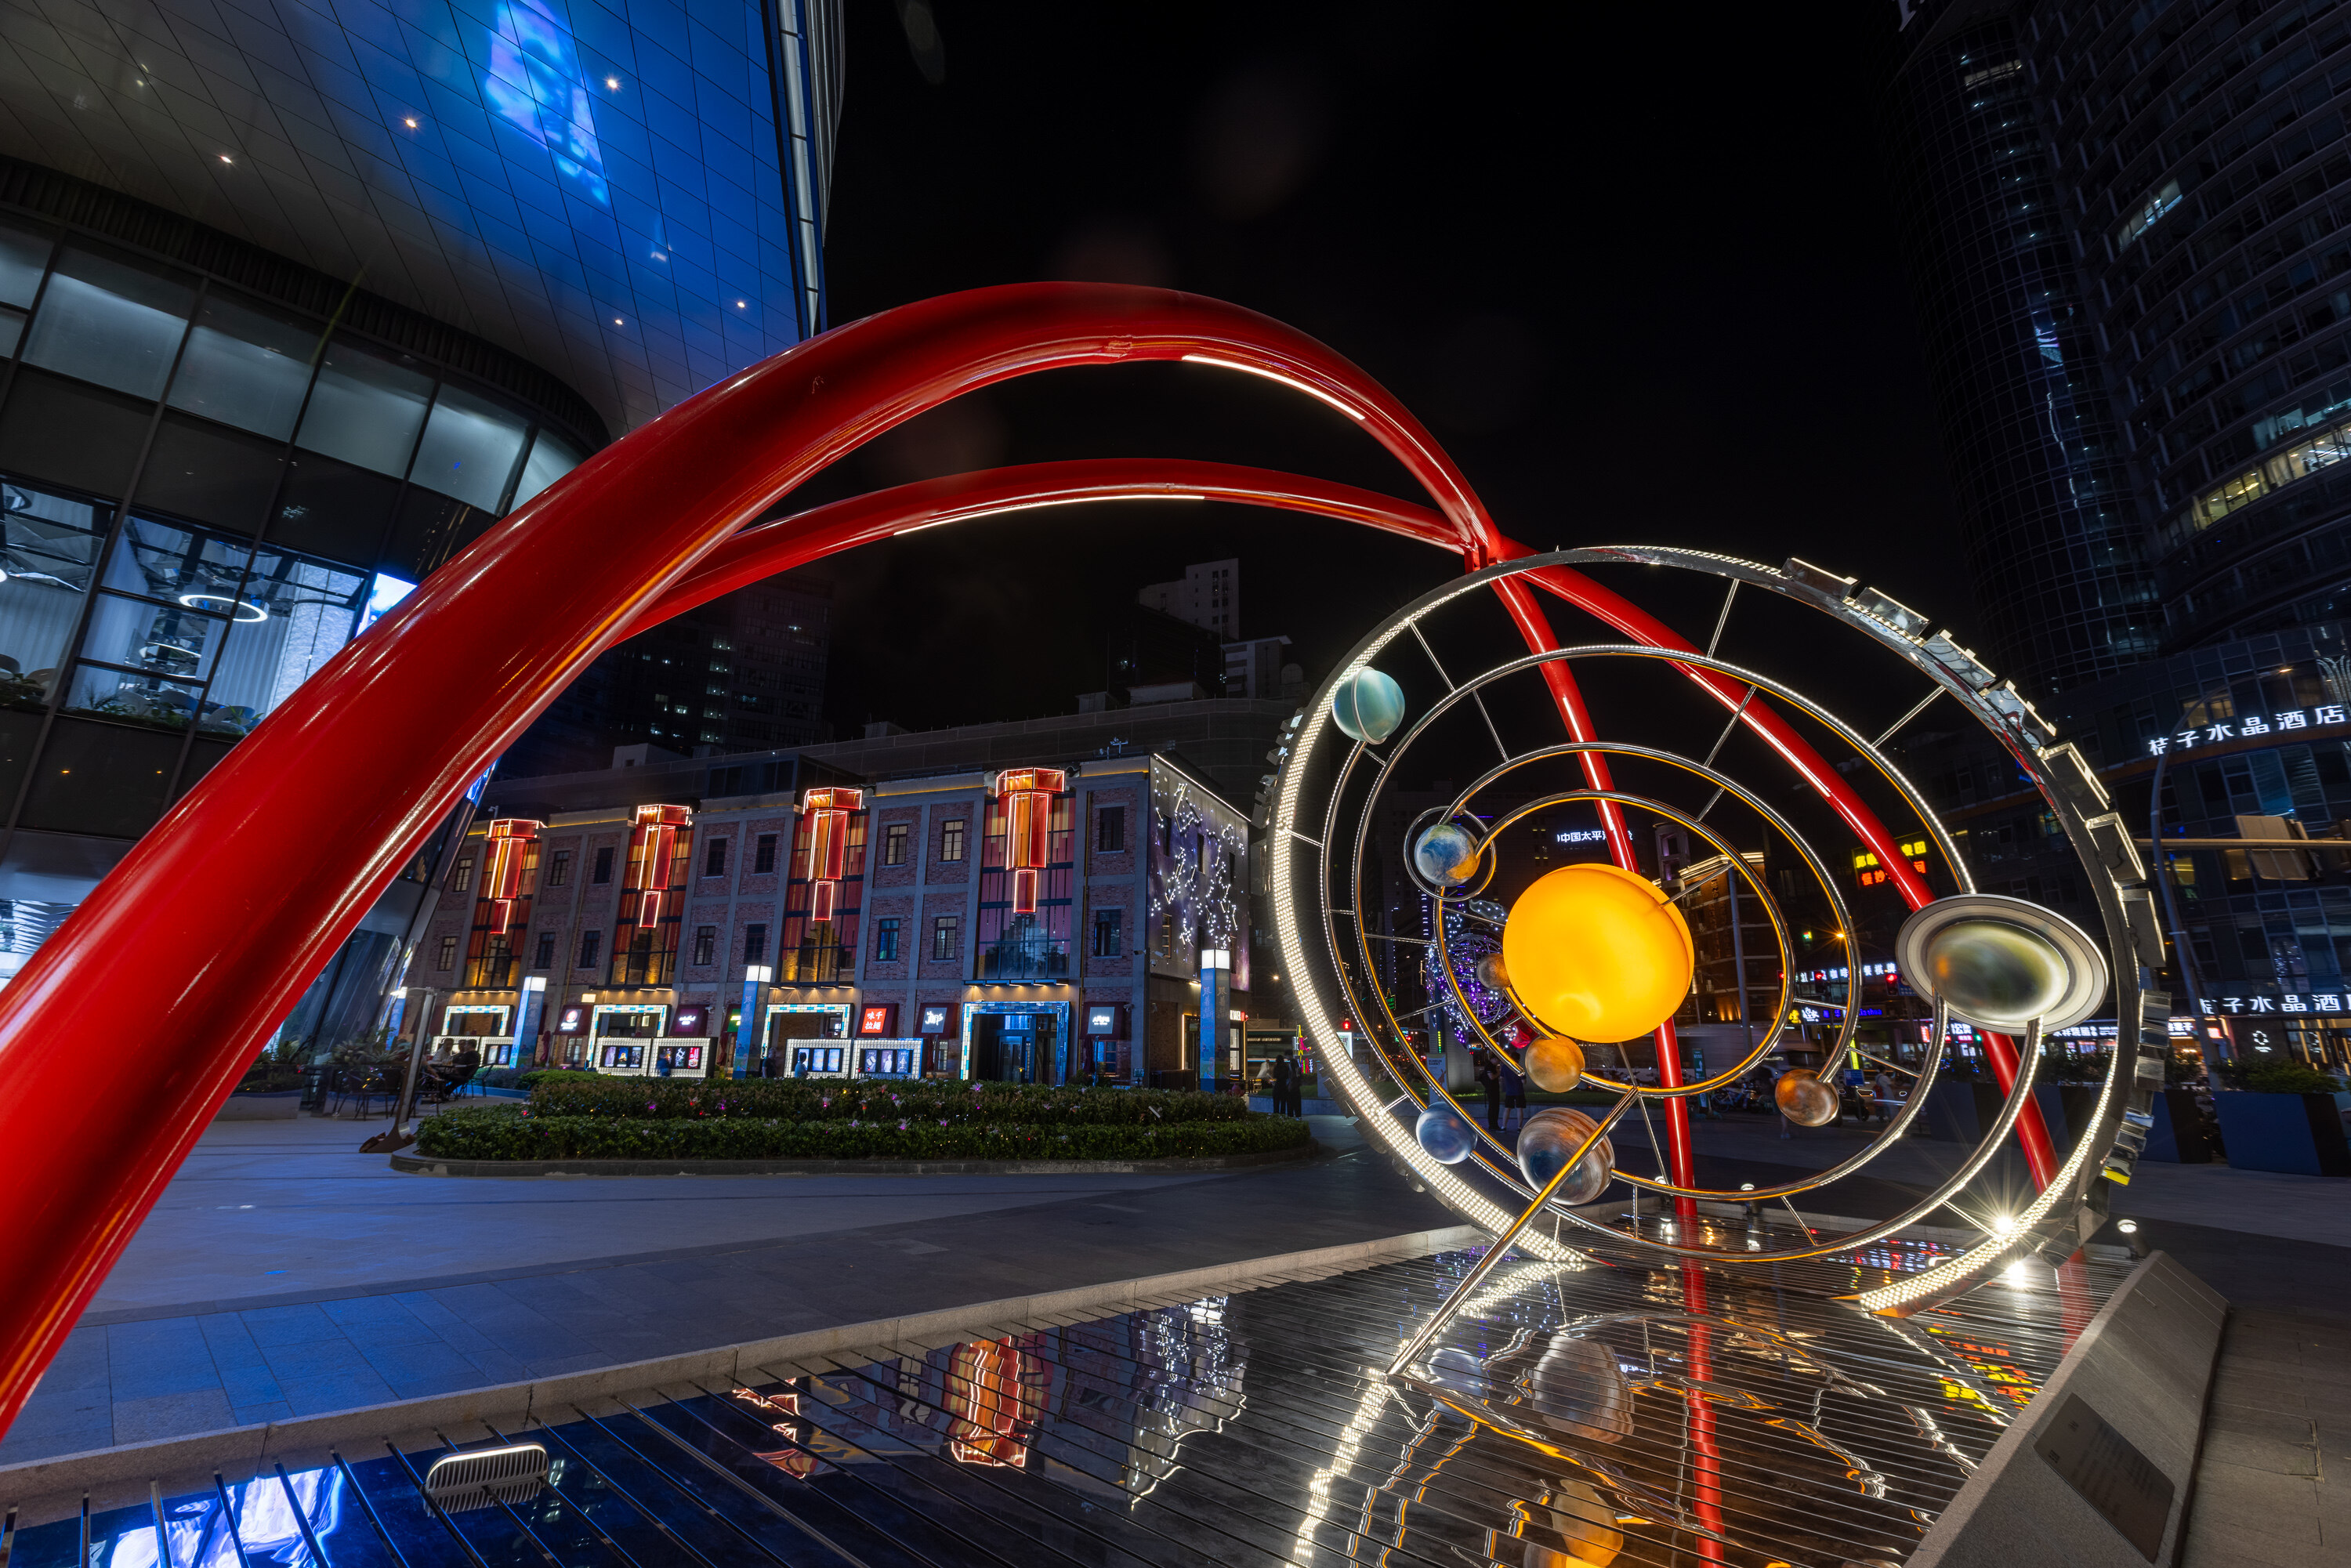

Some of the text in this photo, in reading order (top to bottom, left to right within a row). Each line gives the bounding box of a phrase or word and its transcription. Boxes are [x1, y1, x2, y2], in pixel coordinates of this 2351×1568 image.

[2199, 994, 2351, 1015] 桔子水晶酒
